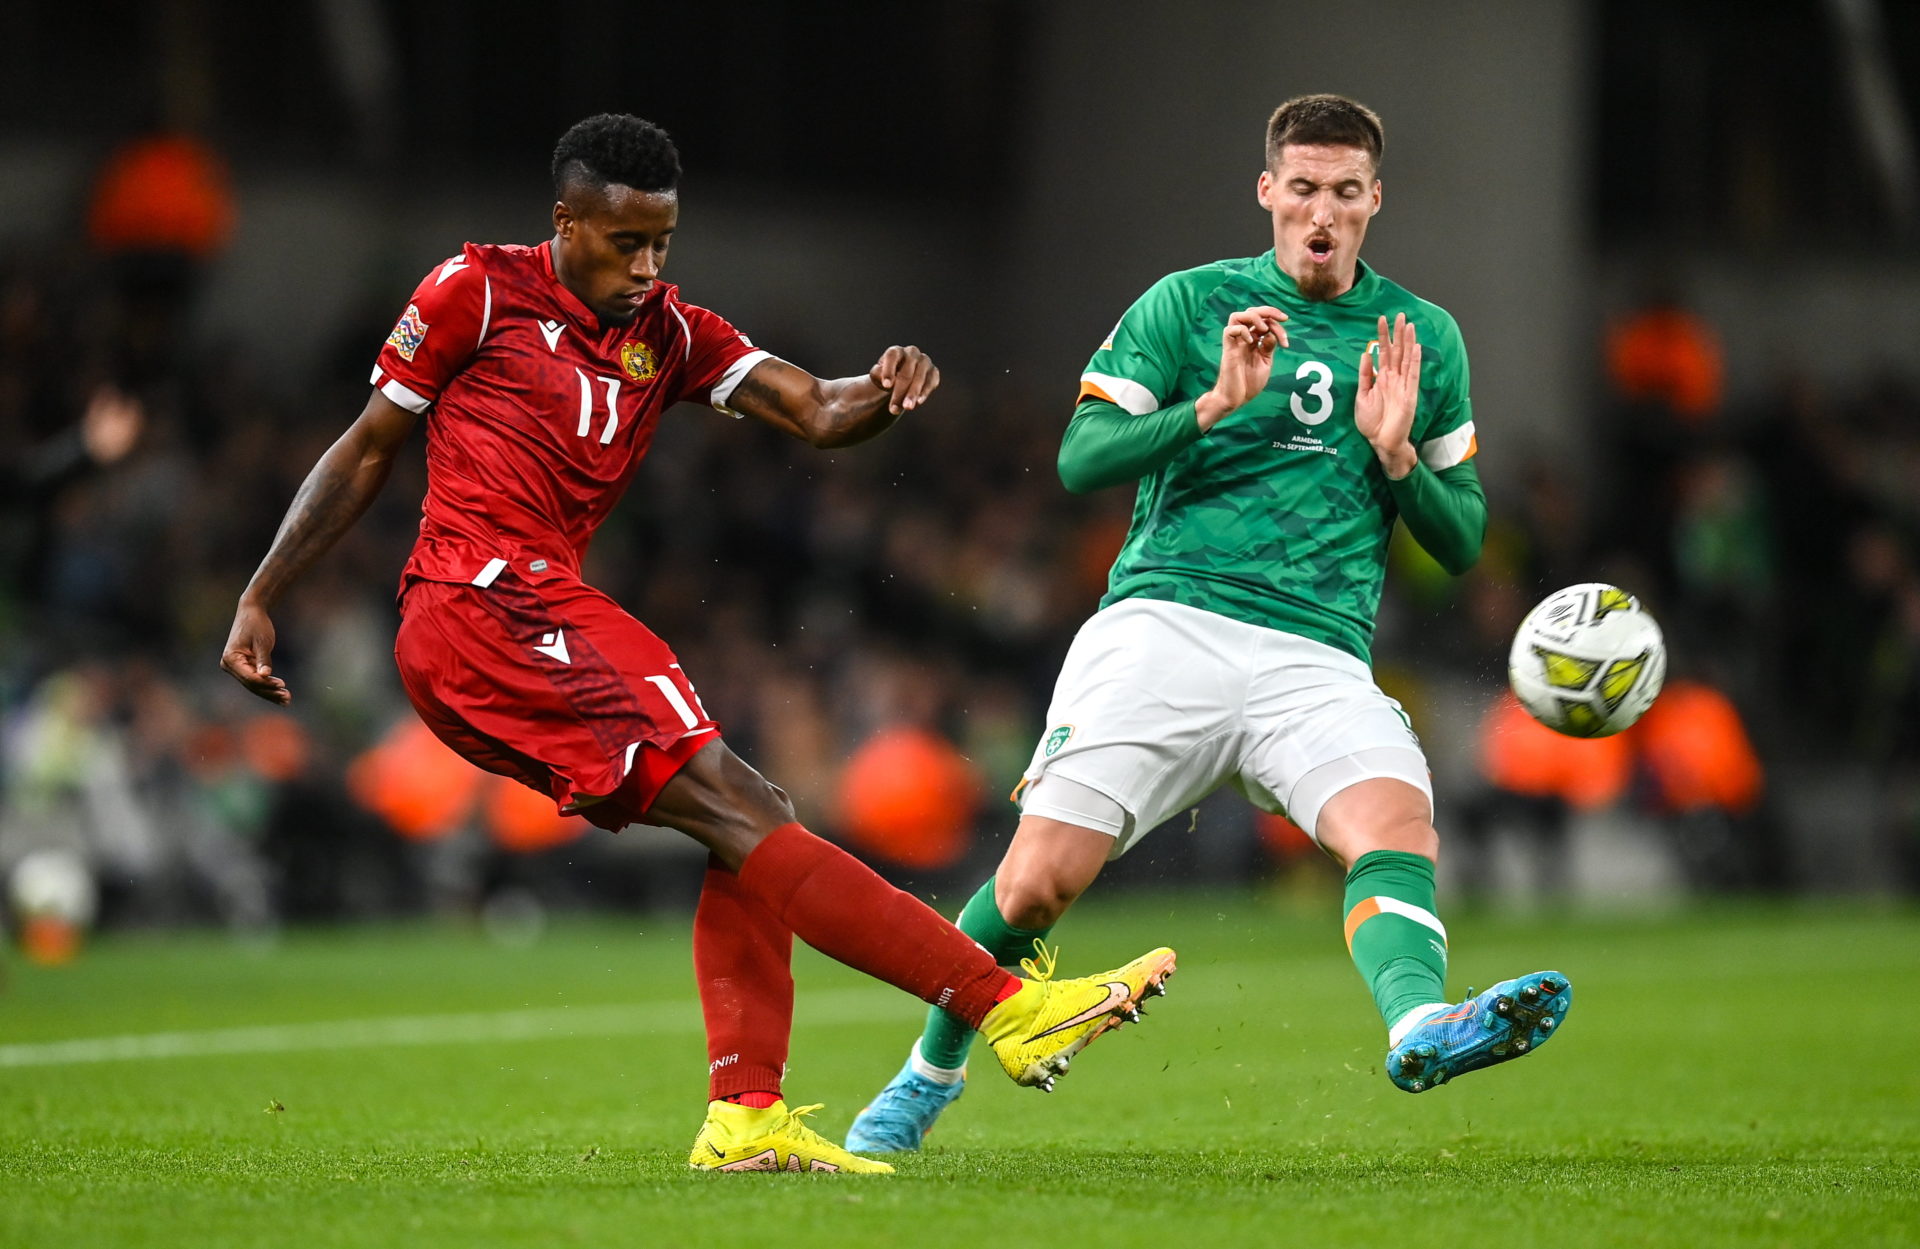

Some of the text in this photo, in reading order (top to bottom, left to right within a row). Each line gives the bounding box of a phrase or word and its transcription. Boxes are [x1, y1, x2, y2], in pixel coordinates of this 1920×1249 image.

[1290, 361, 1333, 425] 3
[1291, 435, 1322, 444] ARMENIA
[1287, 443, 1323, 452] SEPTEMBER
